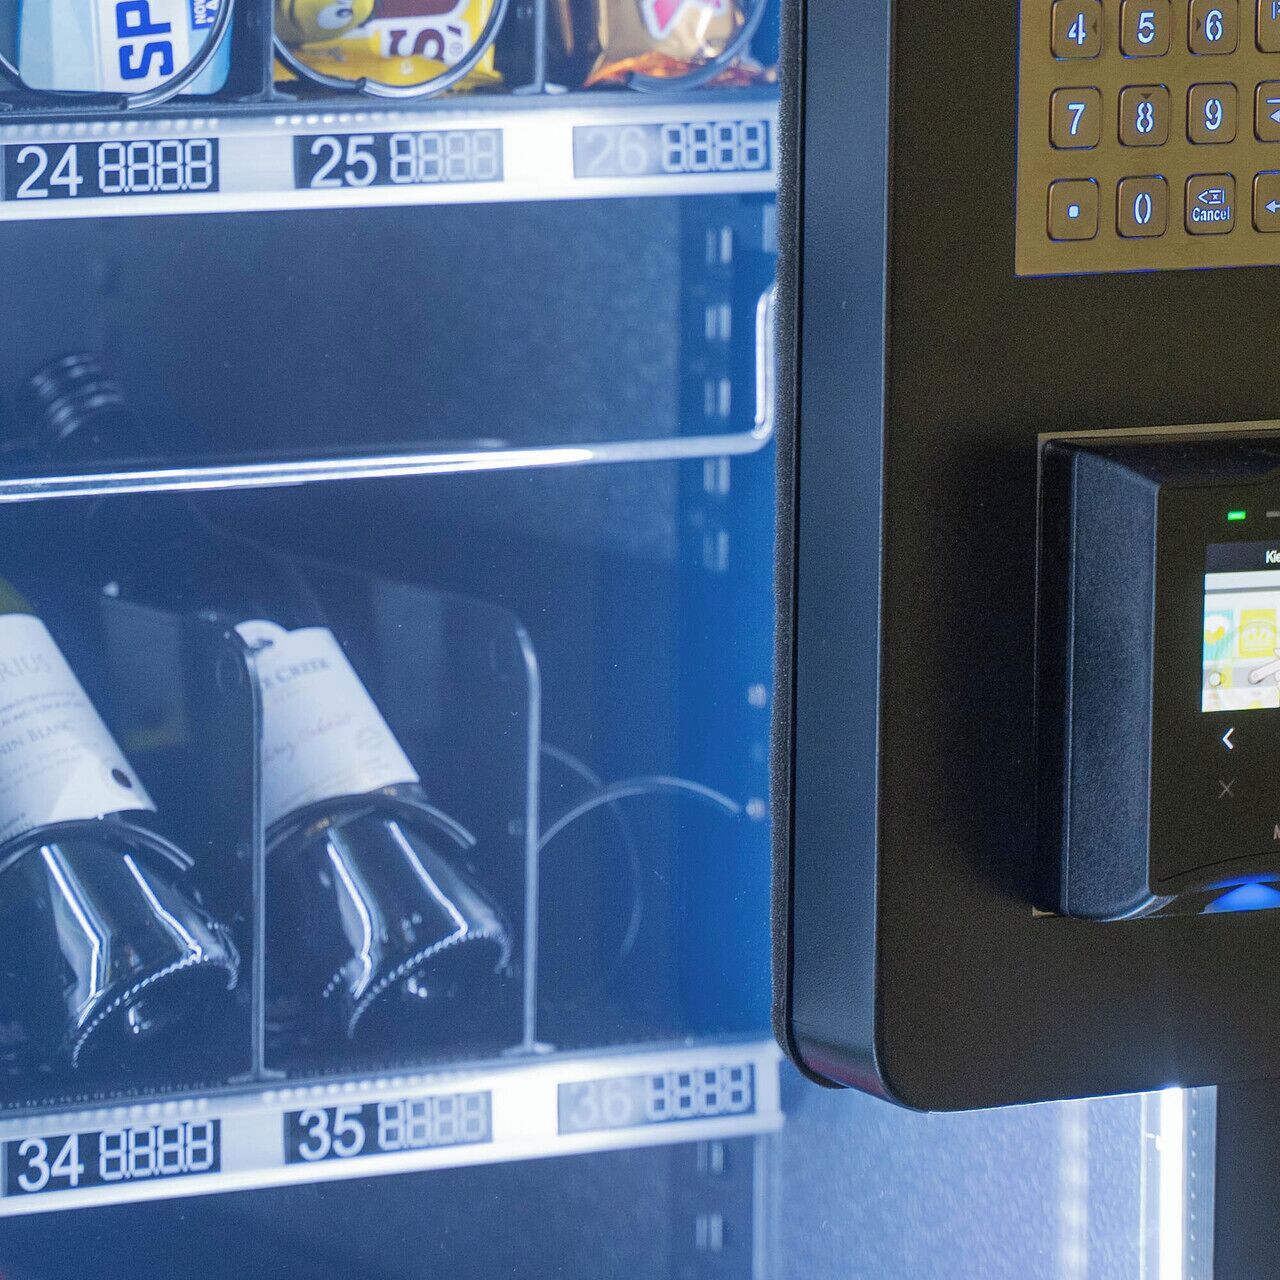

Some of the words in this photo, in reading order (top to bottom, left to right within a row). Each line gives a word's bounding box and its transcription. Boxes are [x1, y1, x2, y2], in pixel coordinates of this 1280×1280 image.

[1068, 13, 1086, 45] 4
[1136, 11, 1156, 44] 5
[1204, 9, 1224, 42] 6
[1067, 103, 1085, 135] 7
[1135, 101, 1154, 133] 8
[1204, 98, 1224, 131] 9
[310, 135, 378, 188] 25
[585, 127, 648, 174] 26
[16, 144, 84, 198] 24
[1133, 193, 1152, 224] 0
[1192, 206, 1231, 222] Cancel
[569, 1079, 633, 1126] 36
[297, 1108, 365, 1161] 35
[17, 1138, 85, 1193] 34
